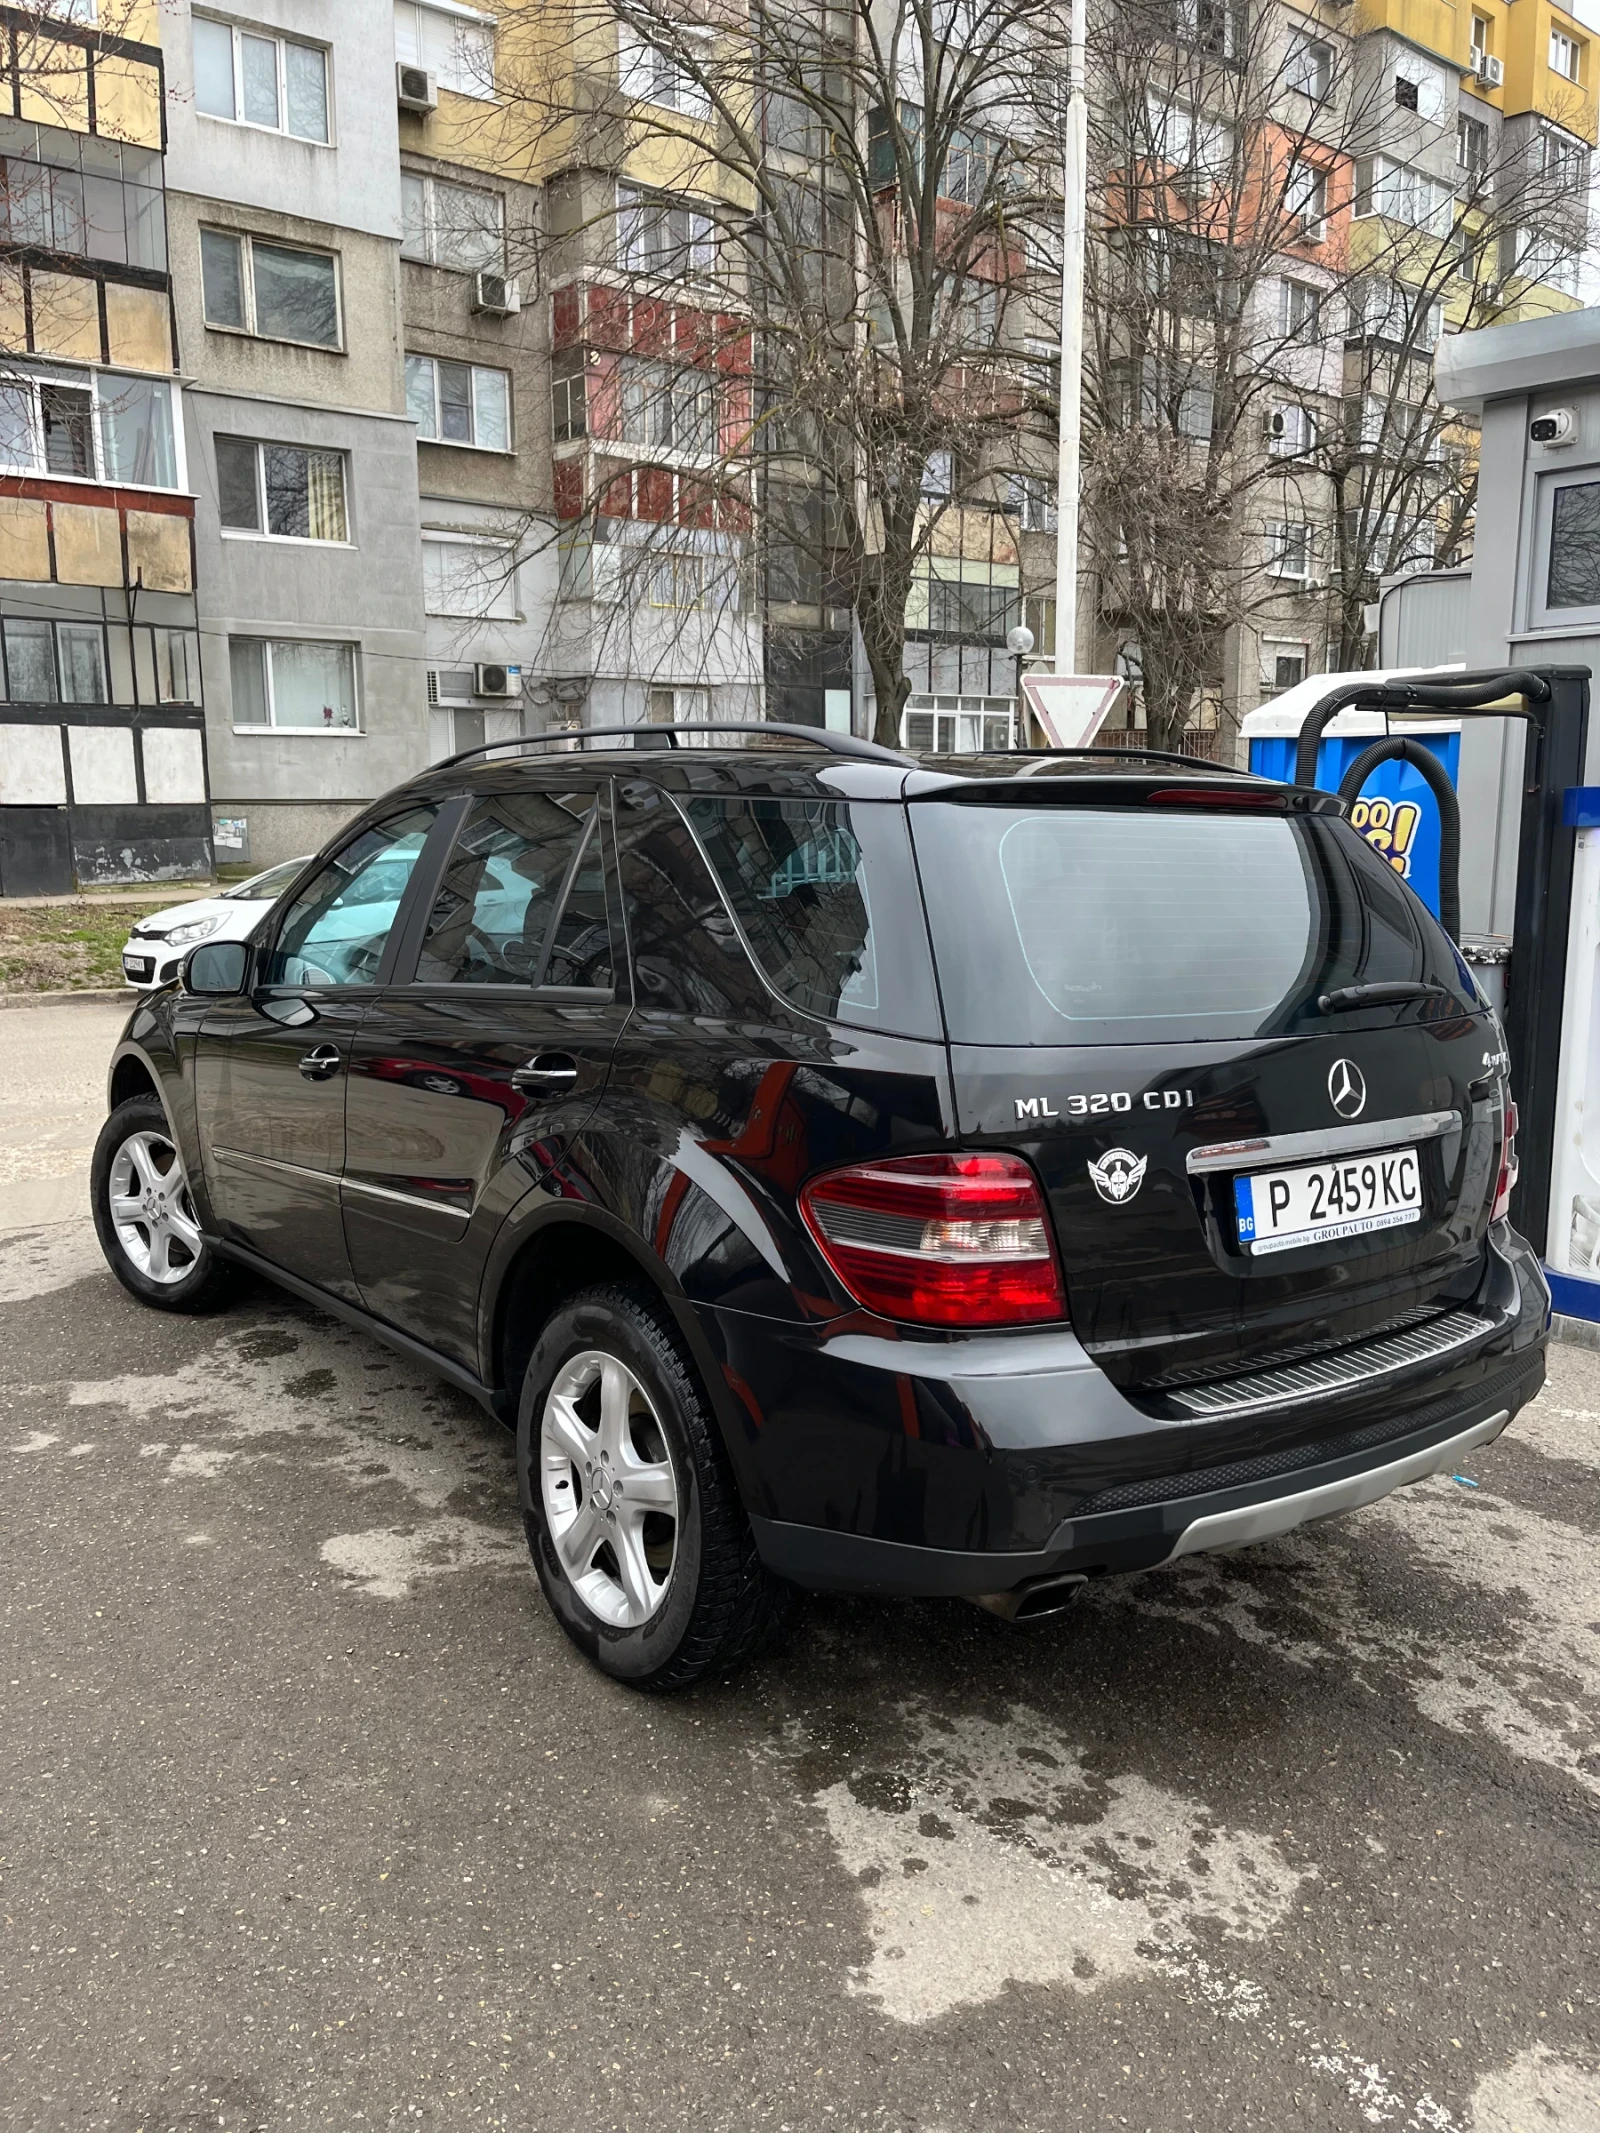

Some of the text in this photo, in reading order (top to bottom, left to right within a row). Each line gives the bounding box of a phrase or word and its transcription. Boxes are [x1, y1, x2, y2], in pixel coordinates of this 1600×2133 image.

[1014, 1089, 1193, 1119] ML 320 CDI
[1269, 1179, 1290, 1227] P
[1238, 1216, 1253, 1232] BG
[1257, 1236, 1310, 1252] groupauto.mobile.bg
[1313, 1220, 1373, 1241] GROUPAUTO
